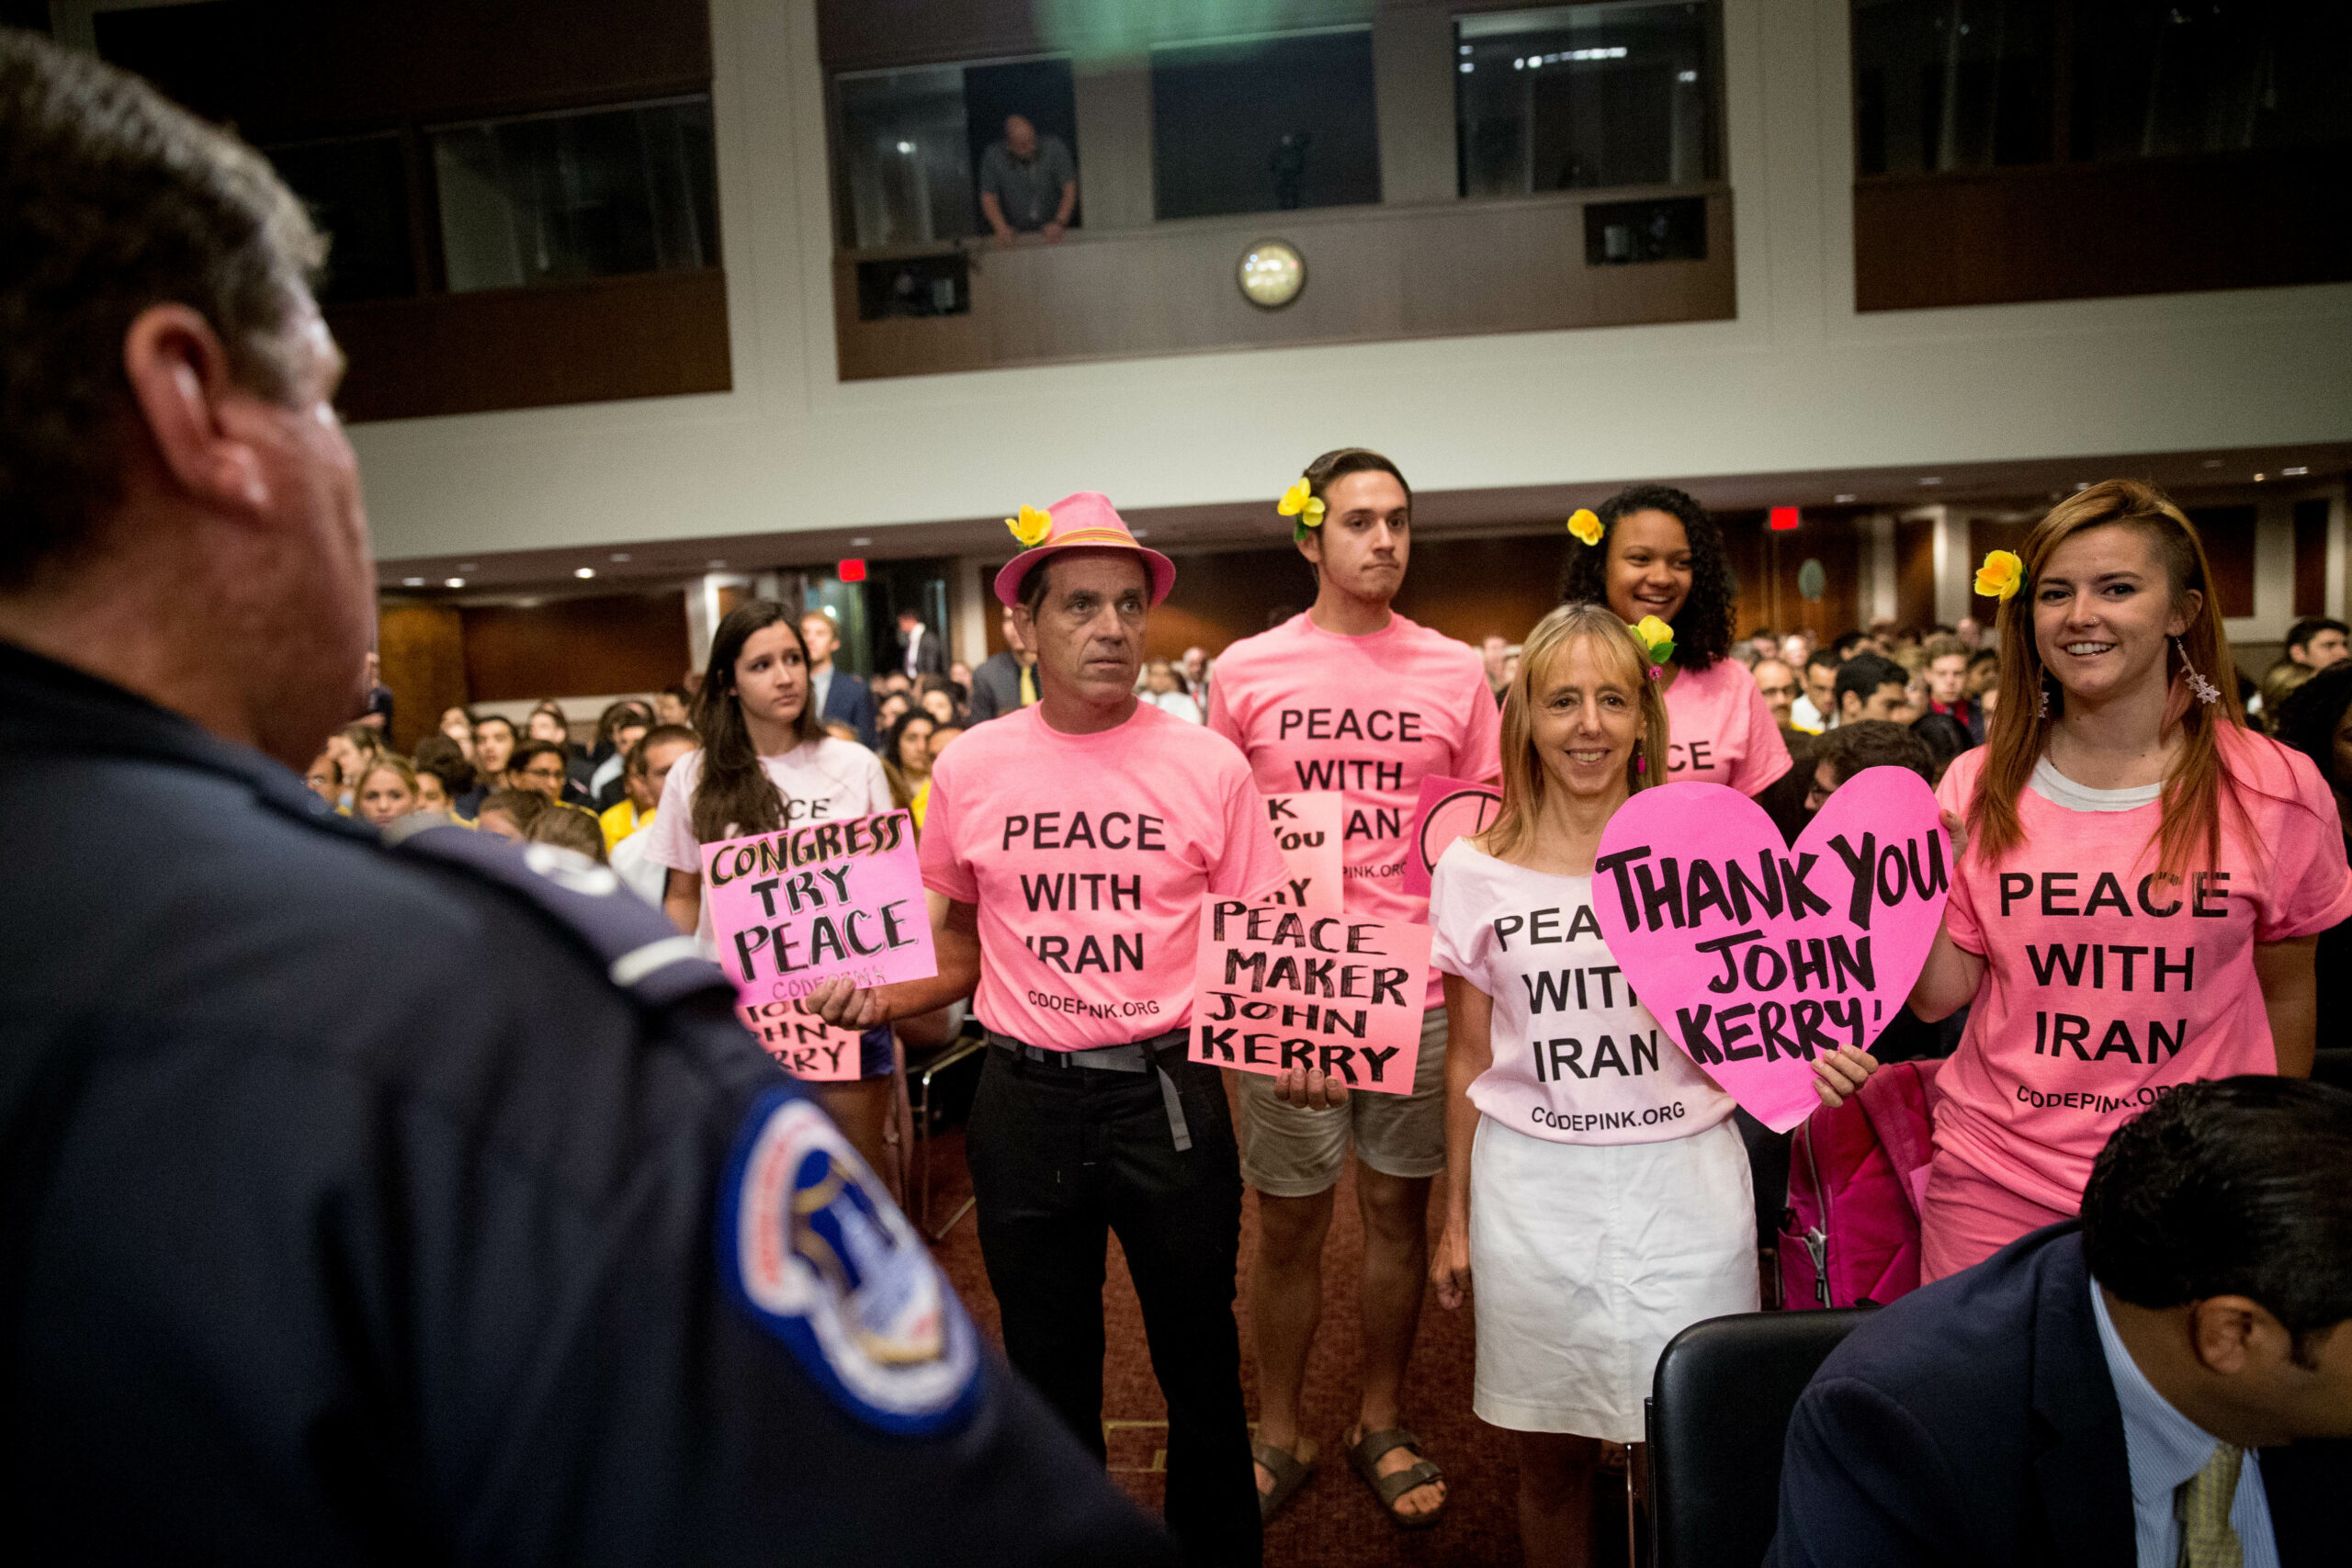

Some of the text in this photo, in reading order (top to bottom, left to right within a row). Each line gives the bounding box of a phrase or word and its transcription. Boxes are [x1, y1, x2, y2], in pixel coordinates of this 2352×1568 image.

[1279, 708, 1422, 742] PEACE
[1295, 760, 1403, 791] WITH
[1002, 811, 1166, 851] PEACE
[1344, 807, 1401, 840] AN
[710, 813, 909, 888] CONGRESS
[751, 863, 853, 920] TRY
[1020, 873, 1141, 911] WITH
[1595, 829, 1950, 932] THANK YOU
[1999, 871, 2231, 918] PEACE
[734, 899, 919, 983] PEACE
[1214, 900, 1388, 955] PEACE
[1494, 904, 1604, 952] PEA
[1026, 932, 1145, 974] IRAN
[1225, 948, 1409, 1007] MAKER
[1695, 929, 1876, 994] JOHN
[2025, 943, 2195, 992] WITH
[1204, 991, 1368, 1038] JOHN
[1676, 997, 1882, 1066] KERRY!
[2035, 1011, 2187, 1064] IRAN
[1202, 1025, 1400, 1086] KERRY
[1533, 1030, 1659, 1082] IRAN
[1532, 1101, 1685, 1131] CODEPINK.ORG
